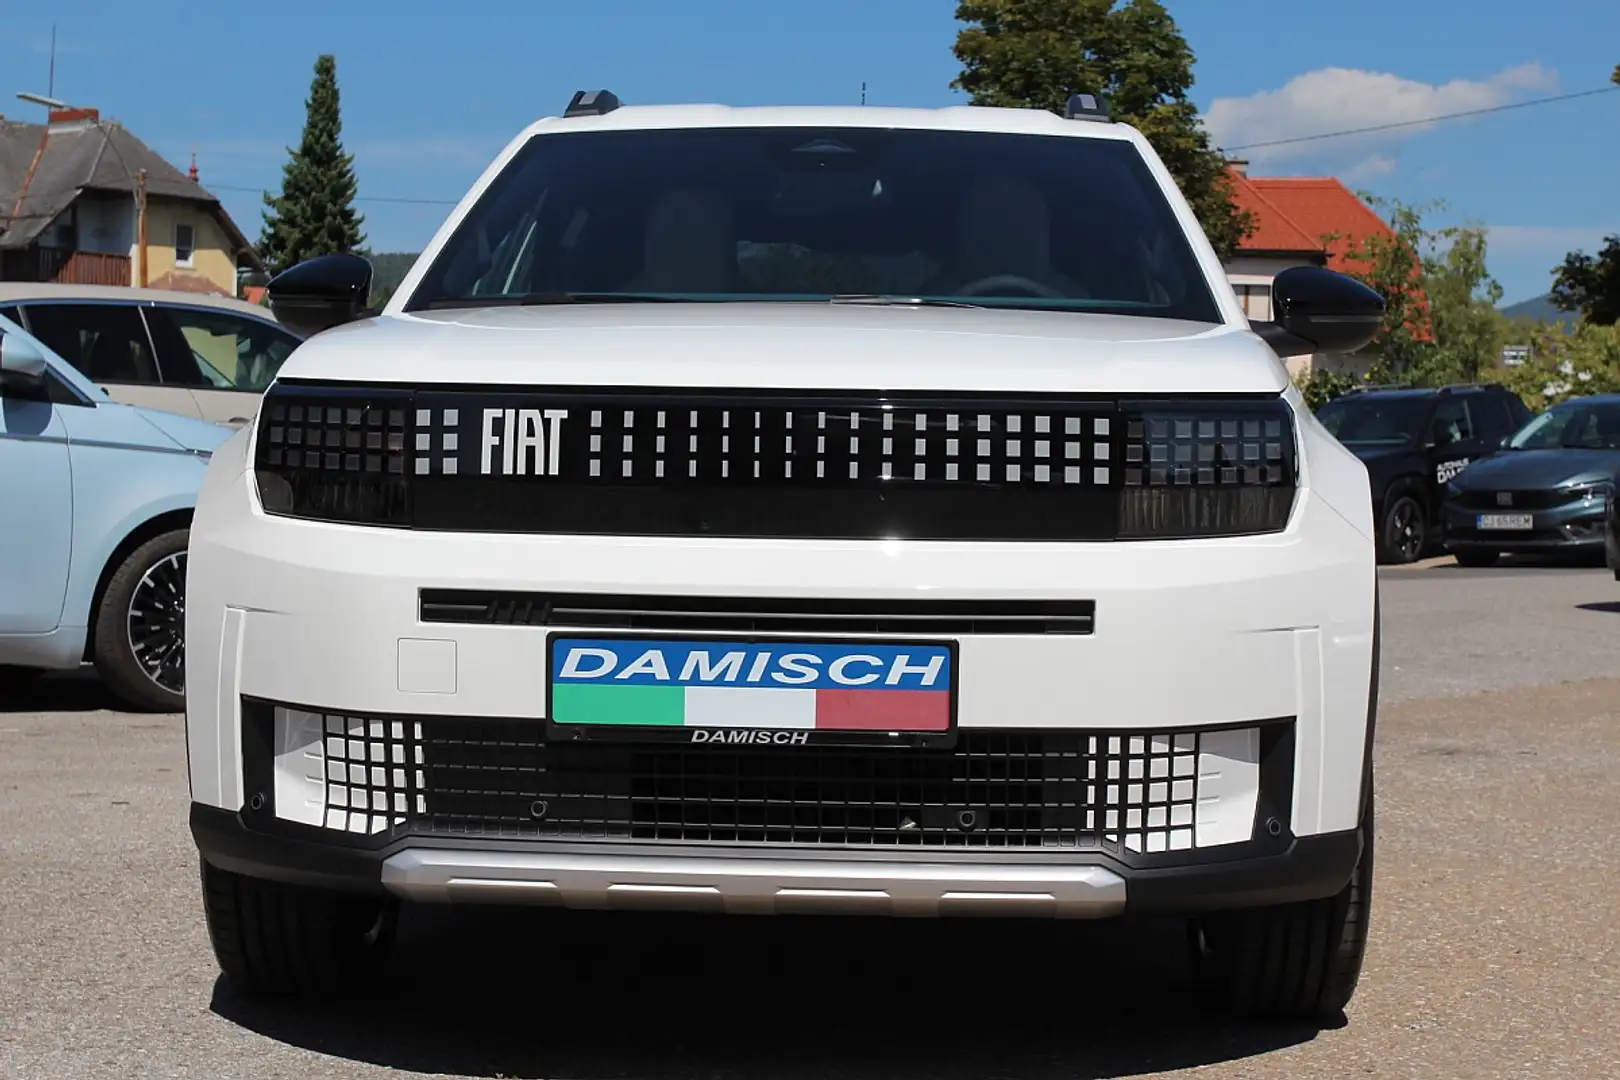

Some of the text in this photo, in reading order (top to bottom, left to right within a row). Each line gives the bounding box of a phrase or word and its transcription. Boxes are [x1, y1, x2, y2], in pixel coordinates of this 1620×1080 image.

[481, 408, 568, 476] FIAT
[559, 648, 945, 686] DAMISCH
[691, 729, 809, 745] DAMISCH
